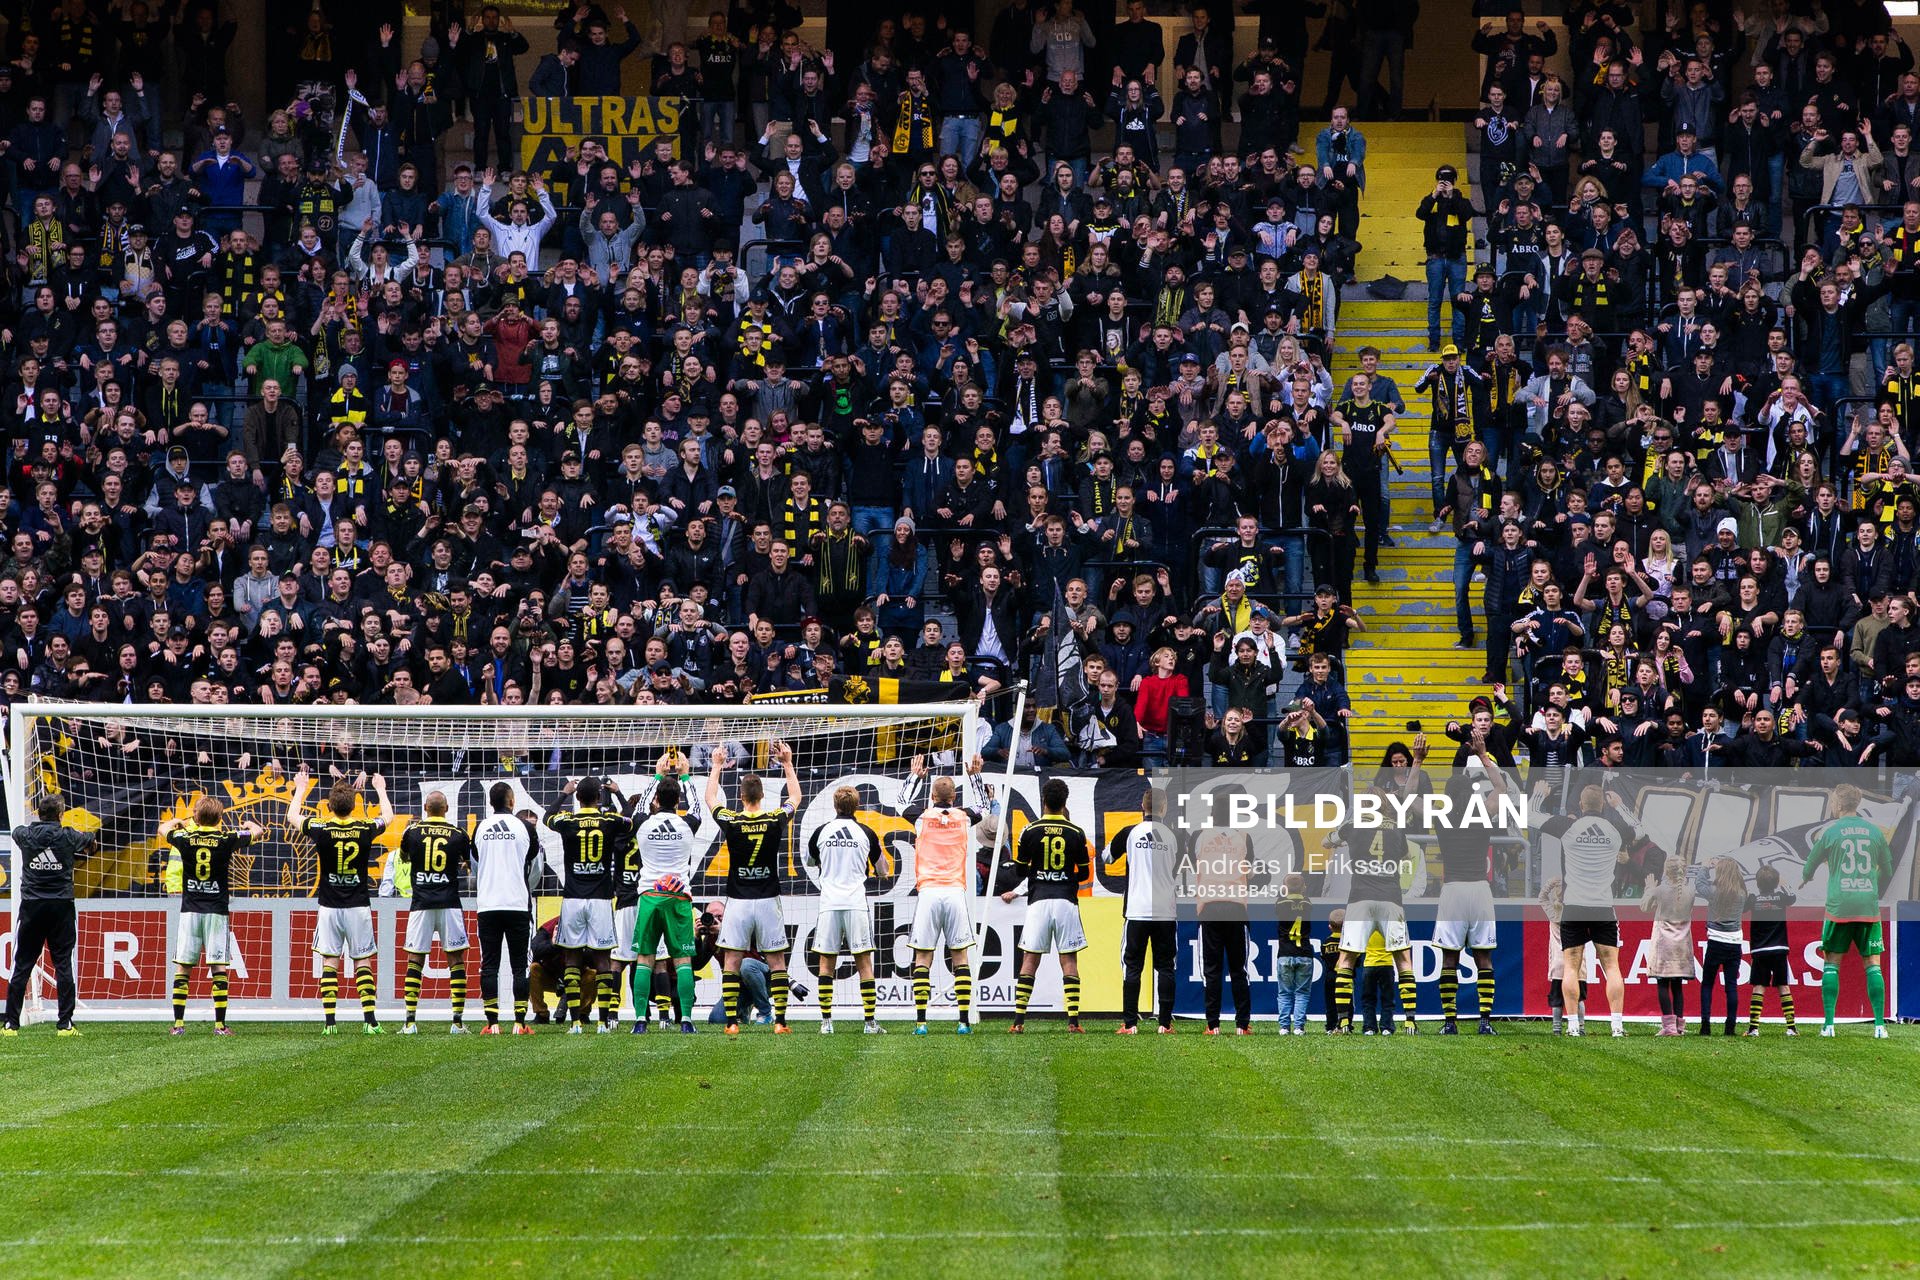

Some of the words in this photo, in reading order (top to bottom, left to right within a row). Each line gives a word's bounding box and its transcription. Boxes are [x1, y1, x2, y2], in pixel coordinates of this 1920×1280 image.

[523, 96, 681, 134] ULTRAS
[527, 136, 678, 180] AK
[321, 217, 332, 227] 27
[483, 832, 517, 842] adidas
[648, 832, 683, 842] adidas
[1576, 836, 1612, 846] adidas
[576, 830, 605, 863] 10
[825, 838, 860, 849] adidas
[1135, 840, 1169, 852] adidas
[422, 836, 449, 873] 16
[624, 837, 640, 872] 2
[748, 833, 765, 867] 7
[1040, 835, 1067, 871] 18
[333, 841, 360, 875] 12
[1840, 838, 1873, 875] 35
[30, 861, 64, 871] adidas
[196, 847, 212, 881] 8
[573, 862, 605, 873] SVEA
[329, 873, 361, 884] SVEA
[416, 871, 450, 883] SVEA
[622, 871, 640, 882] SV
[738, 867, 771, 878] SVEA
[1036, 870, 1069, 882] SVEA
[186, 879, 220, 890] SVEA
[1841, 878, 1873, 889] SVEA
[1289, 915, 1303, 948] 4
